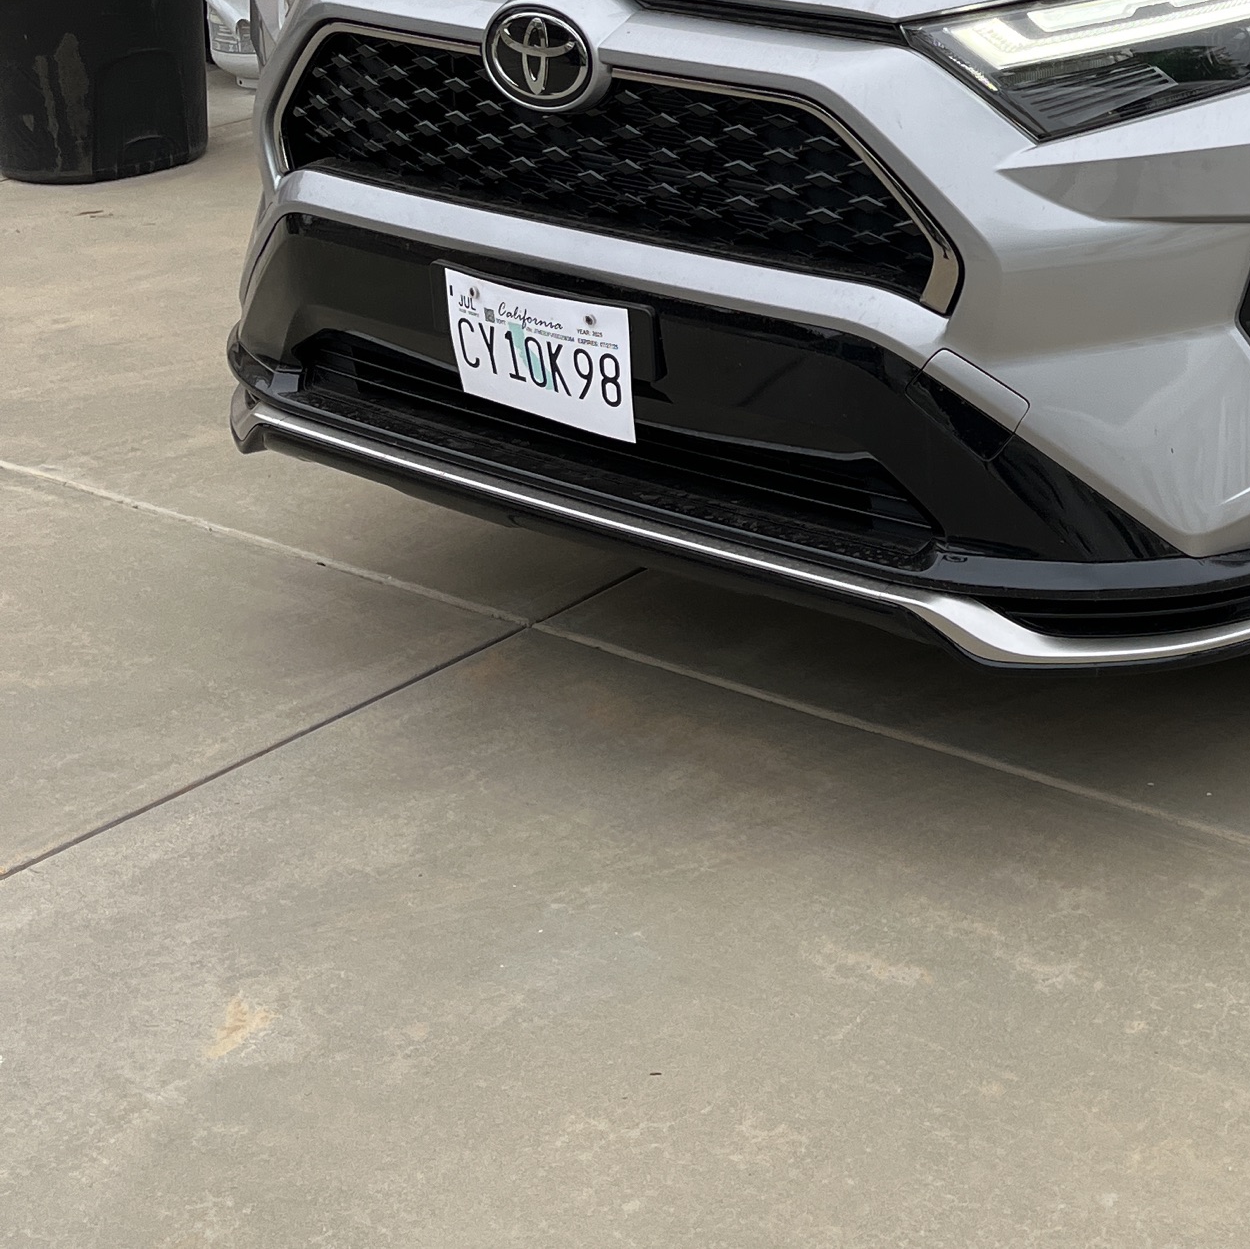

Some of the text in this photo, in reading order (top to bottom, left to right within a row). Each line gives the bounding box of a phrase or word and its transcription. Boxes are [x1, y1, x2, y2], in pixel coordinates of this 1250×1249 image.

[458, 294, 476, 311] JUL
[498, 302, 563, 330] California
[457, 317, 622, 408] CY10K98
